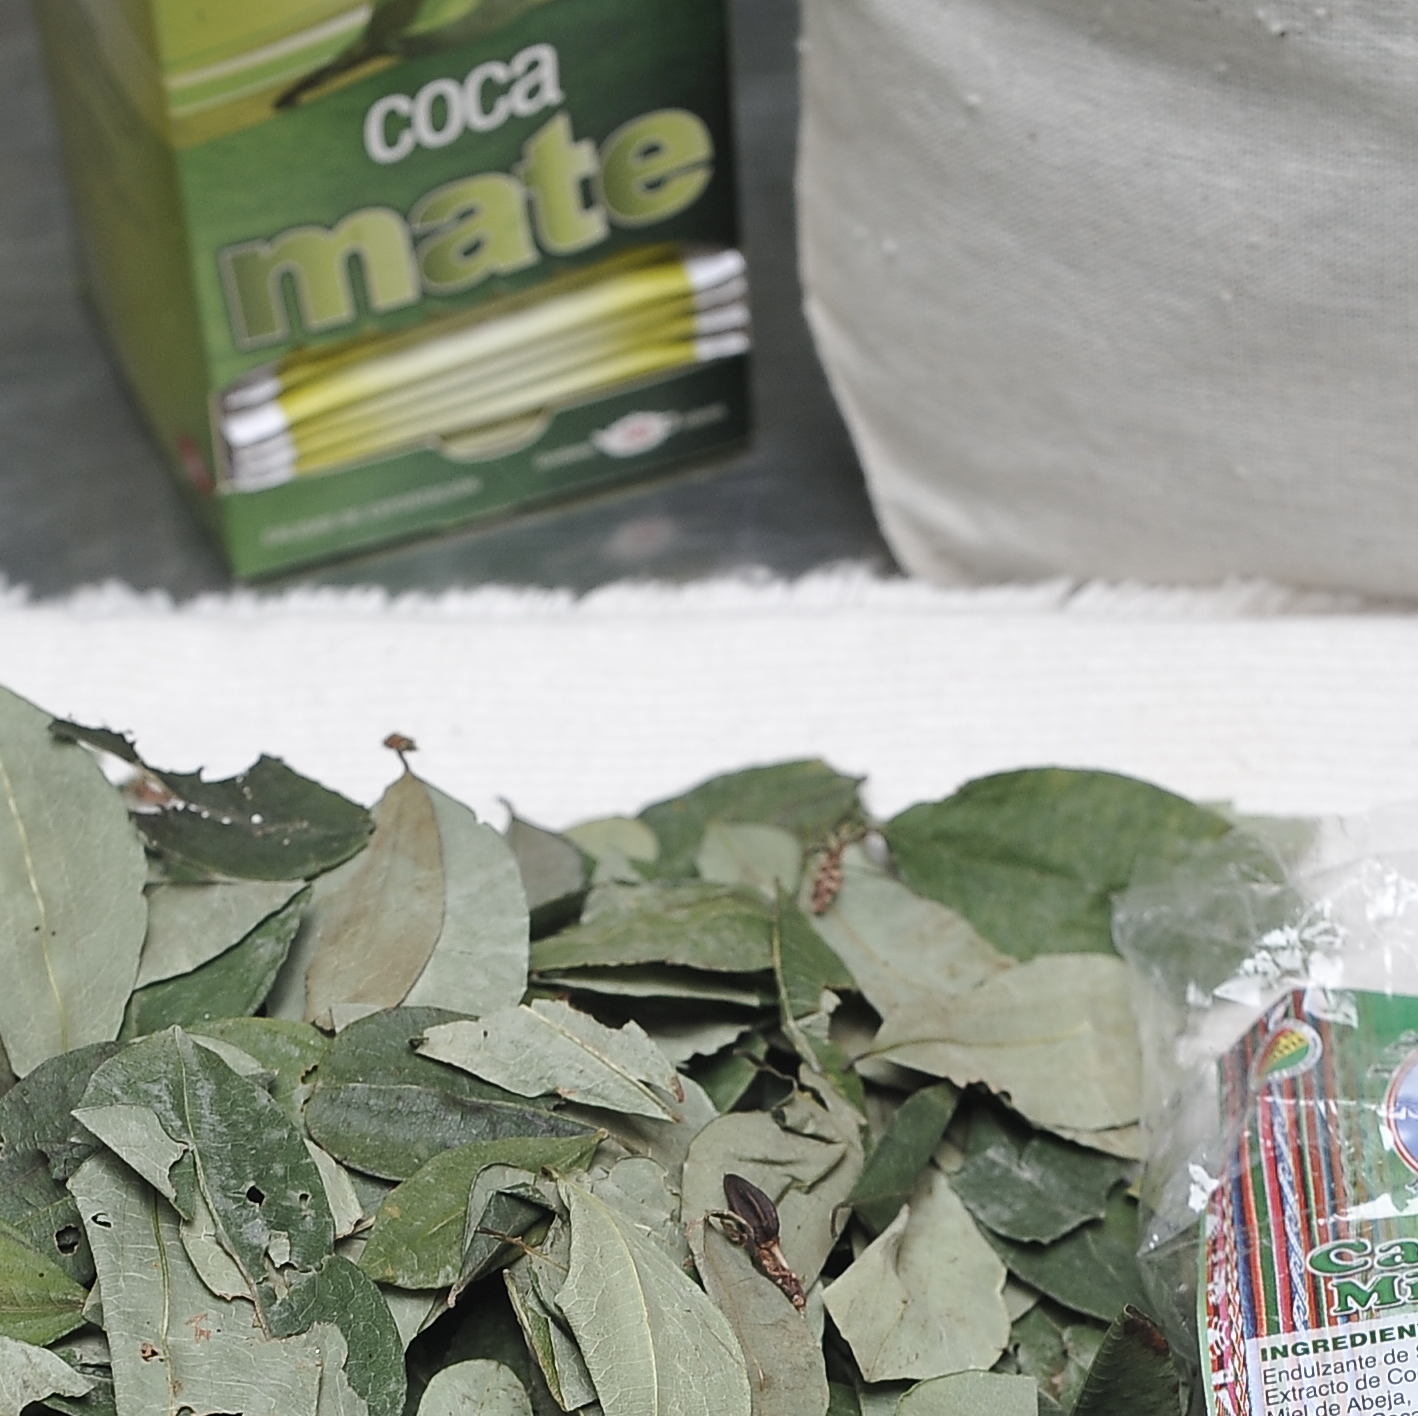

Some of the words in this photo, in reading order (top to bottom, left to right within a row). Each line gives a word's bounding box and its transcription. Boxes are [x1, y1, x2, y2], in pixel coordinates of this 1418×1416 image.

[364, 44, 564, 164] coca
[222, 109, 714, 350] mate
[1263, 1356, 1377, 1385] Endulzante
[1383, 1347, 1409, 1366] de
[1265, 1381, 1349, 1406] Extracto
[1355, 1372, 1381, 1391] de
[1315, 1397, 1342, 1416] de
[1347, 1390, 1412, 1415] Abeja,
